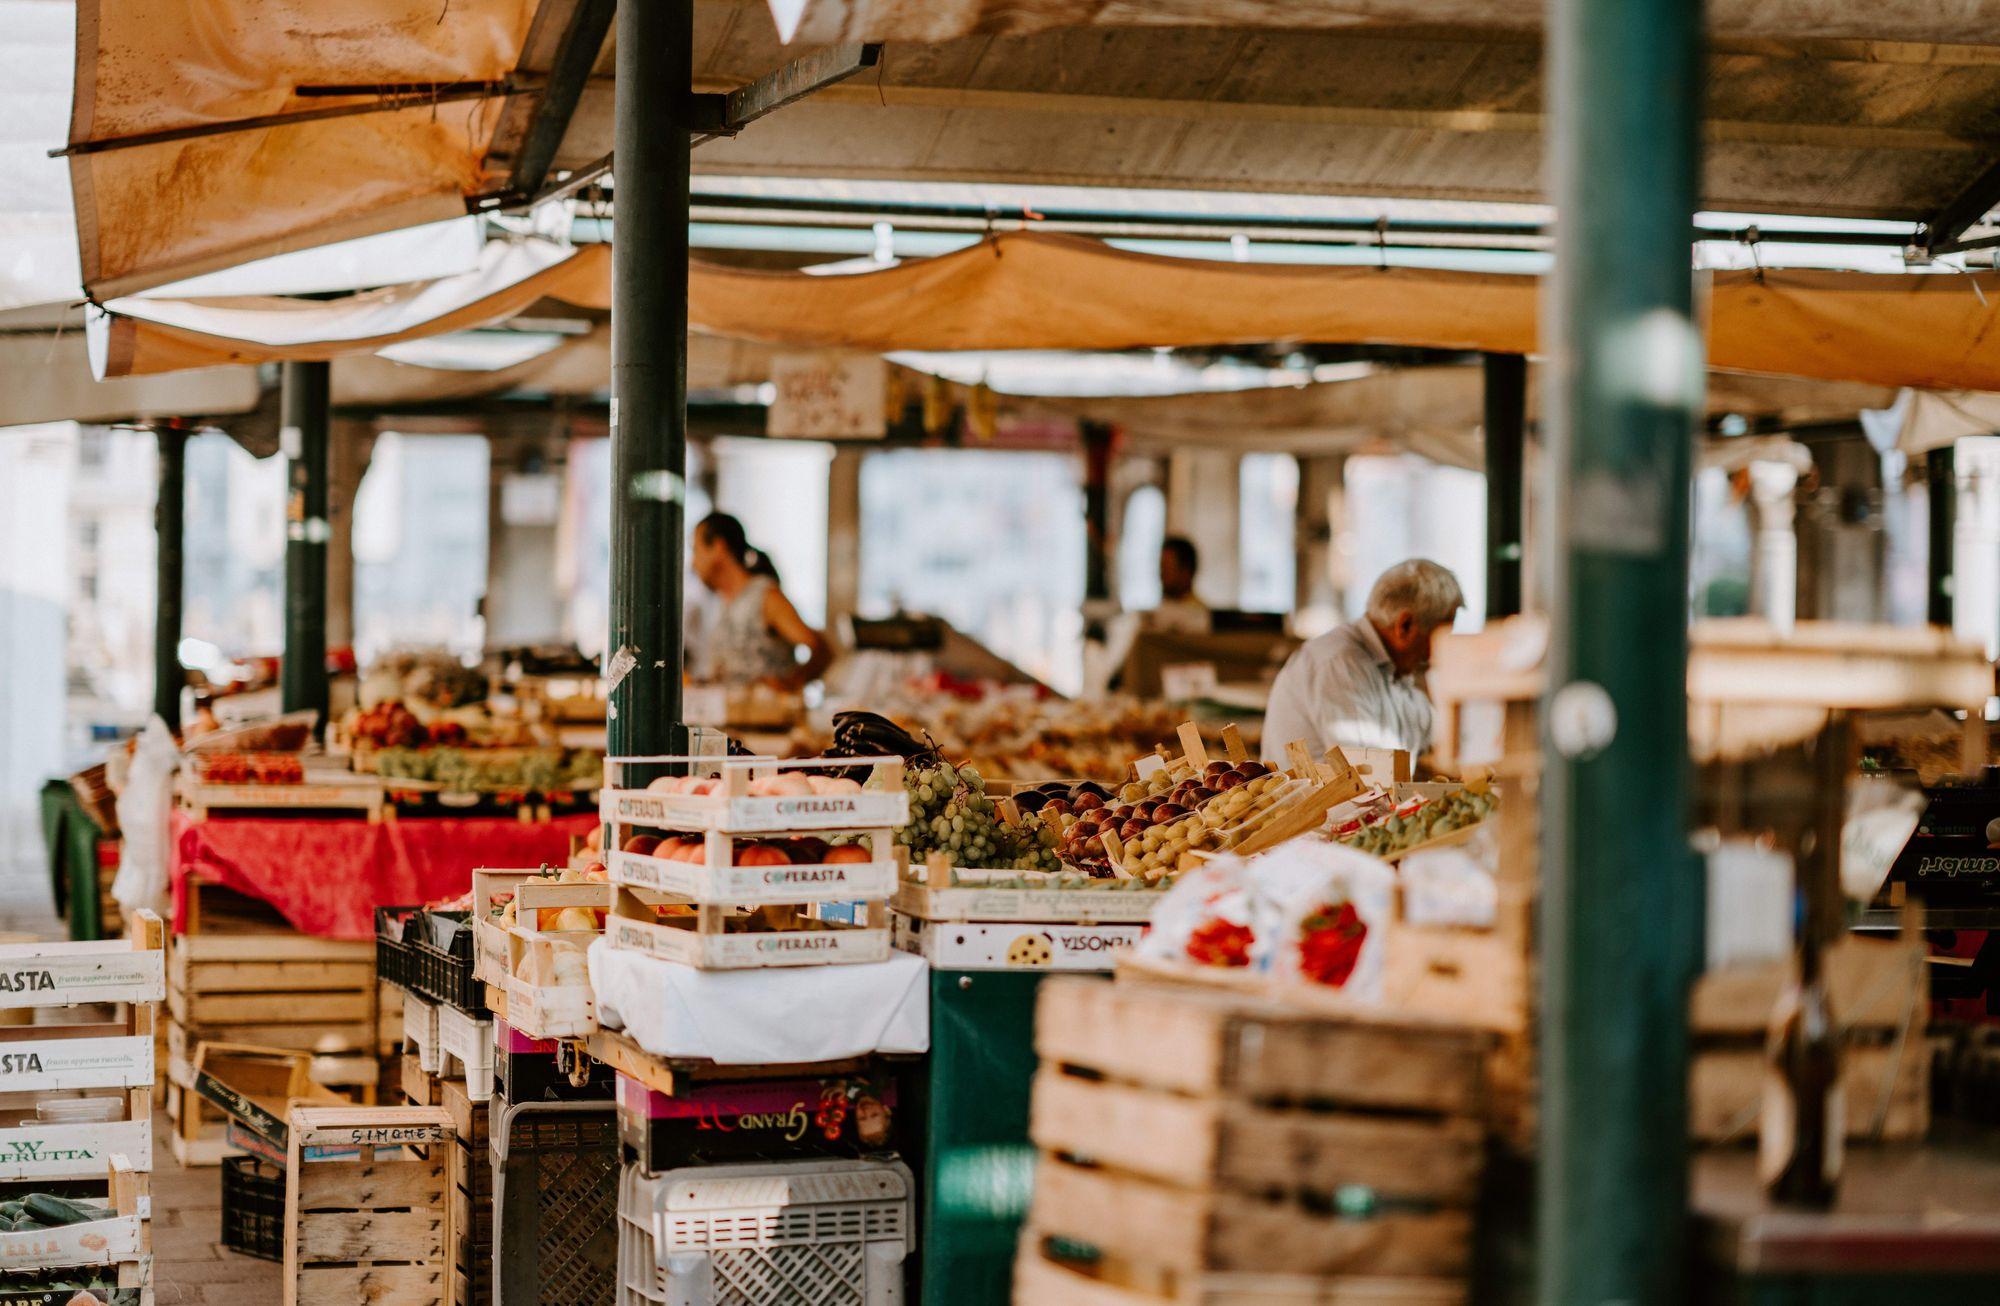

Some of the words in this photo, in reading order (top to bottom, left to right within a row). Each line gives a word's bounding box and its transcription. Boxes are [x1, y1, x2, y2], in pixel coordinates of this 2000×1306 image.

[776, 800, 856, 815] COFERASTA
[1918, 856, 2000, 878] embri
[763, 869, 846, 884] COFERASTA
[756, 937, 839, 952] COFERASTA
[0, 971, 55, 992] ASTA
[0, 1053, 43, 1075] STA
[8, 1140, 44, 1153] W
[0, 1150, 94, 1163] FRUTTA
